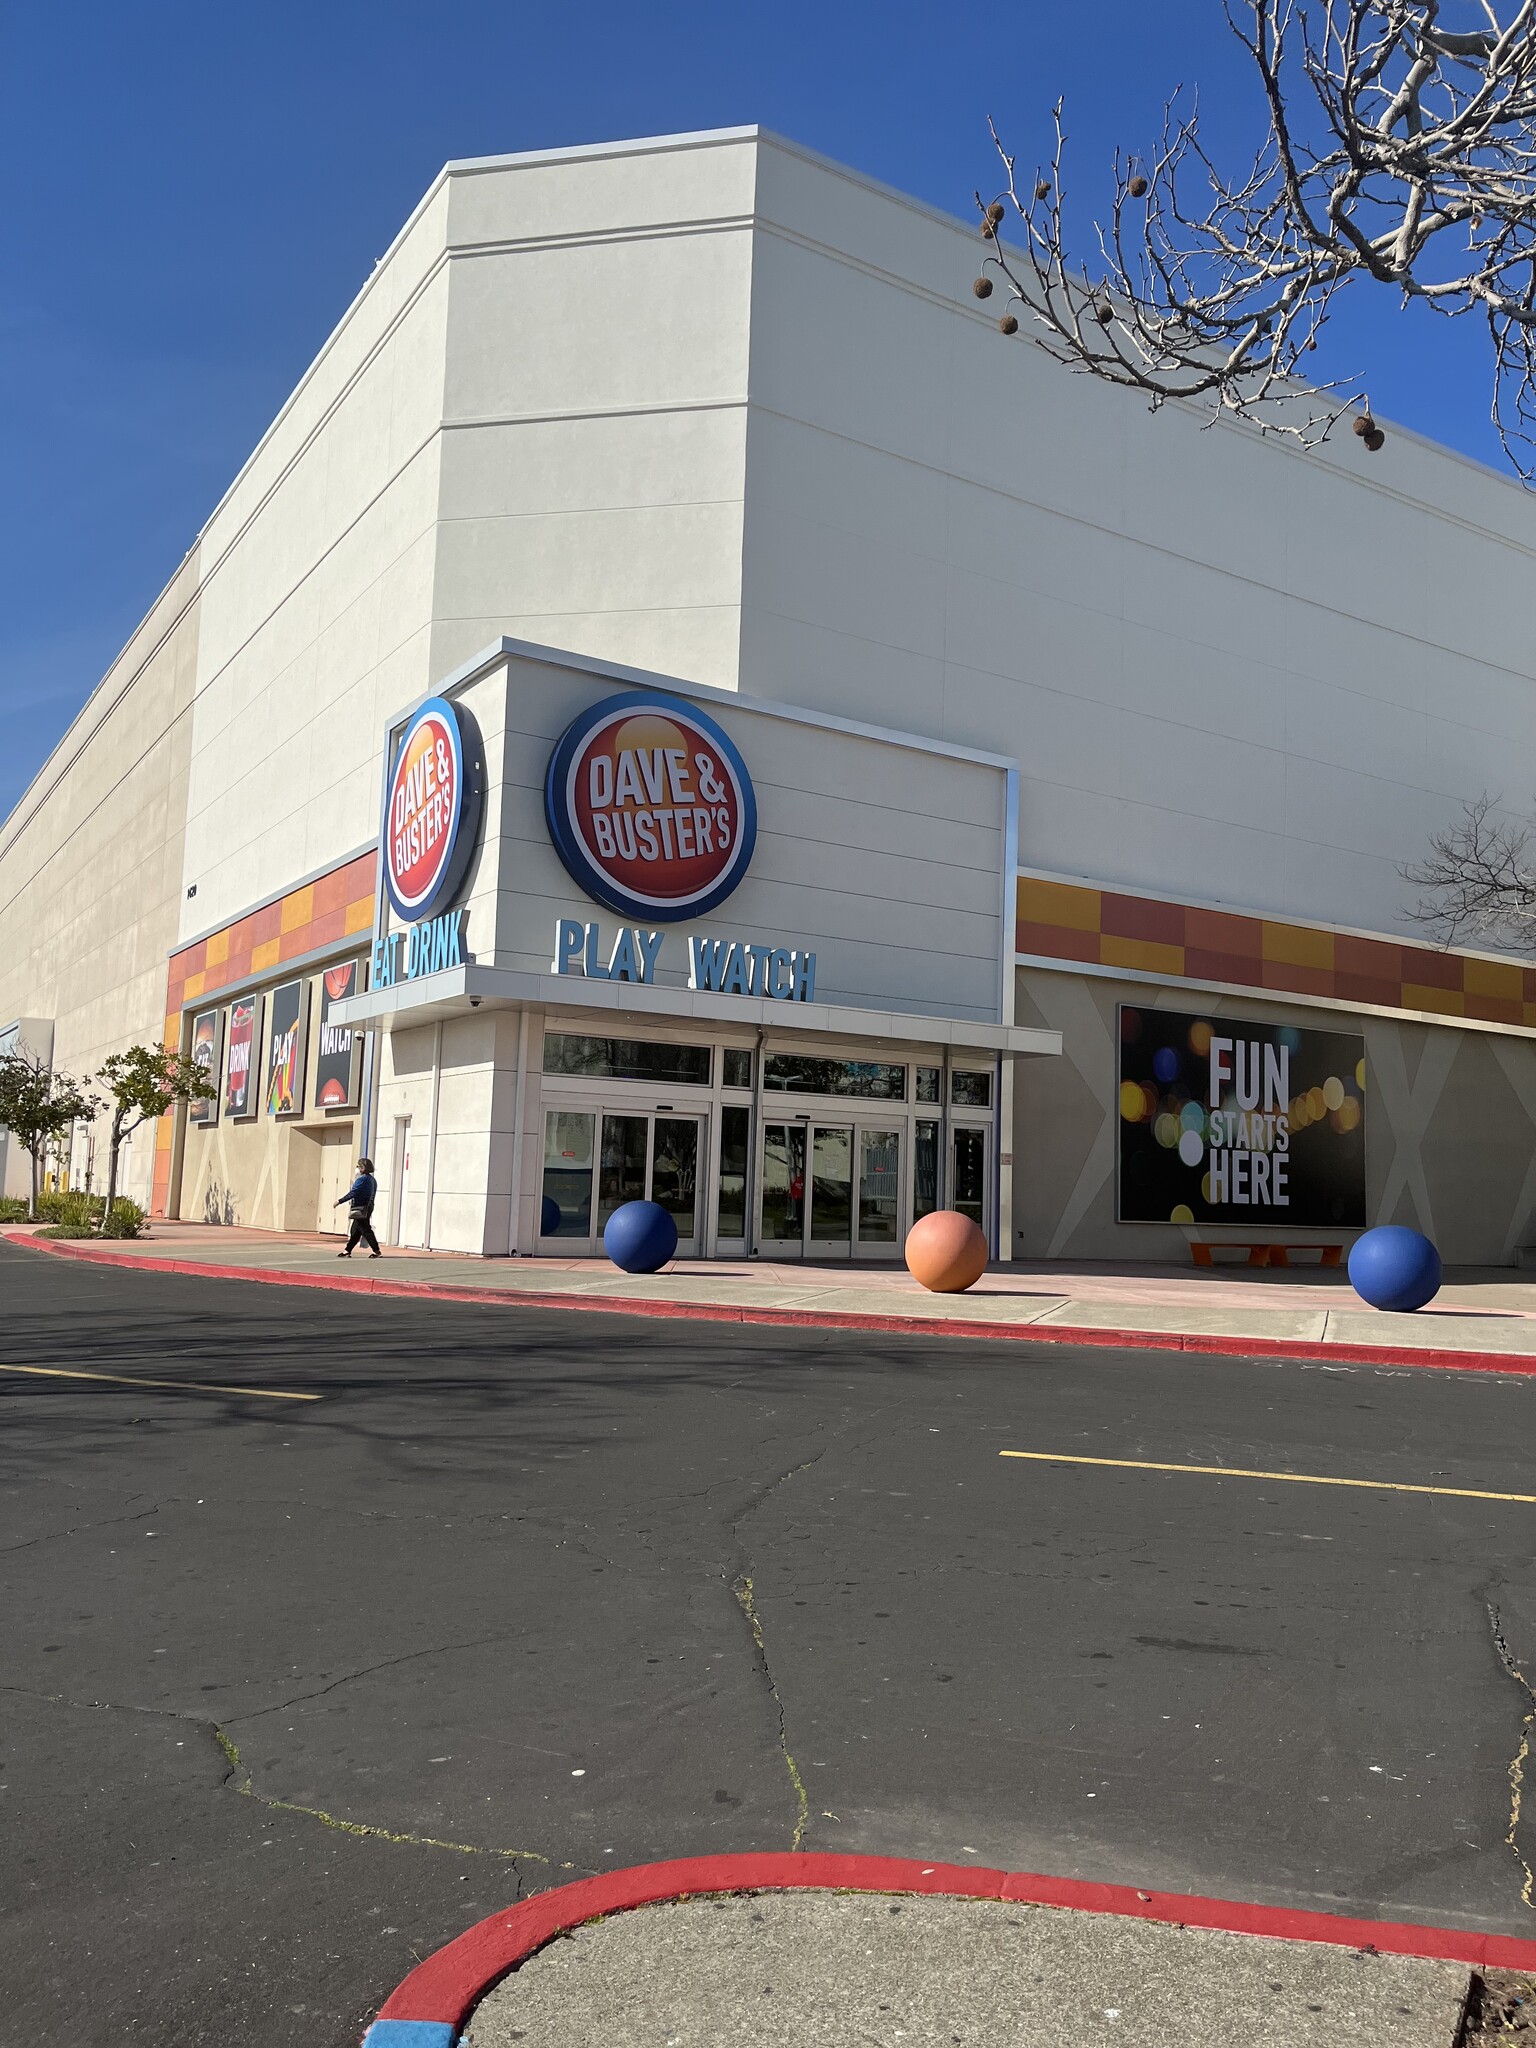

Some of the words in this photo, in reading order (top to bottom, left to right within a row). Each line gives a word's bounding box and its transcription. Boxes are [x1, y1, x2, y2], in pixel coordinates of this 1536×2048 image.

[395, 745, 434, 836] DAVE
[435, 738, 451, 782] &
[588, 747, 690, 809] DAVE
[694, 752, 728, 804] &
[394, 782, 451, 877] BUSTER'S
[592, 806, 731, 862] BUSTER'S
[372, 933, 400, 990] EAT
[407, 909, 463, 980] DRINK
[552, 919, 665, 984] PLAY
[688, 936, 817, 1001] WATCH
[229, 1040, 251, 1074] DRINK
[272, 1032, 294, 1067] PLAY
[1209, 1036, 1289, 1113] FUN
[1209, 1109, 1289, 1152] STARTS
[1209, 1148, 1290, 1206] HERE
